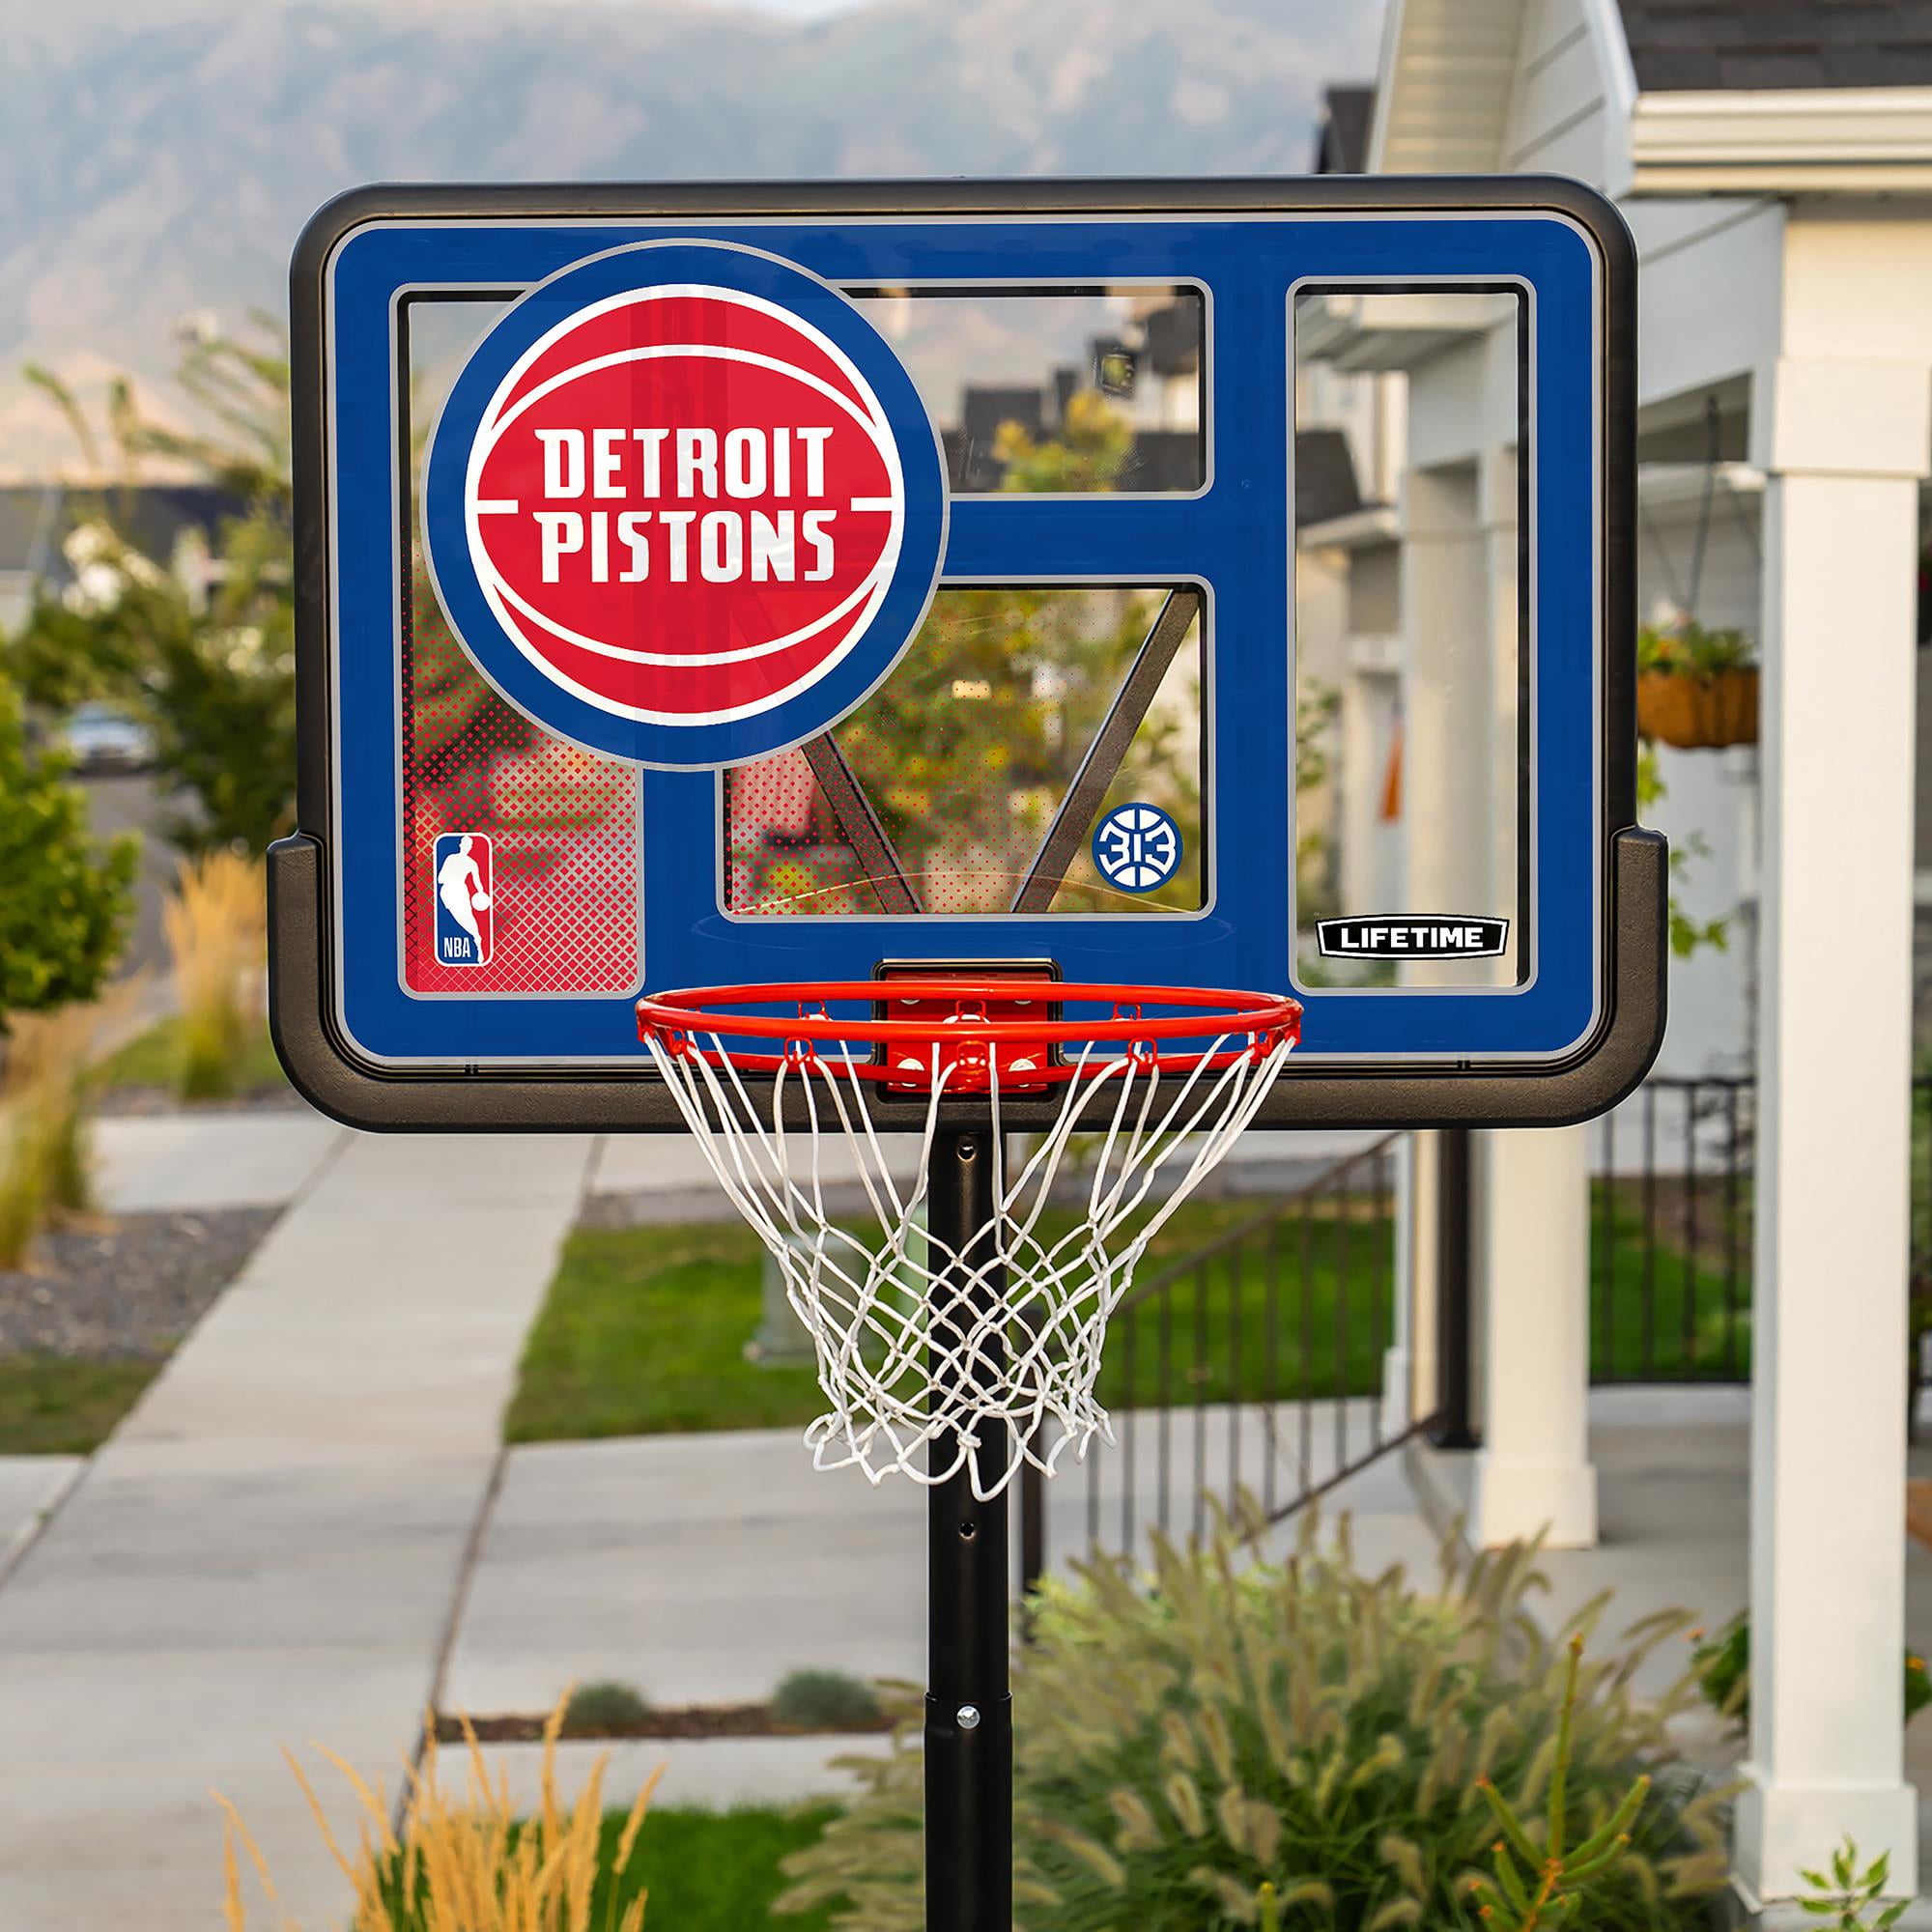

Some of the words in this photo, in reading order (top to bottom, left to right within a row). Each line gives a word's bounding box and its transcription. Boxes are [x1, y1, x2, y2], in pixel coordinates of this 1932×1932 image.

[533, 427, 834, 498] DETROIT
[532, 509, 838, 582] PISTONS
[1098, 821, 1177, 875] 313
[443, 937, 471, 958] NBA
[1341, 927, 1484, 949] LIFETIME
